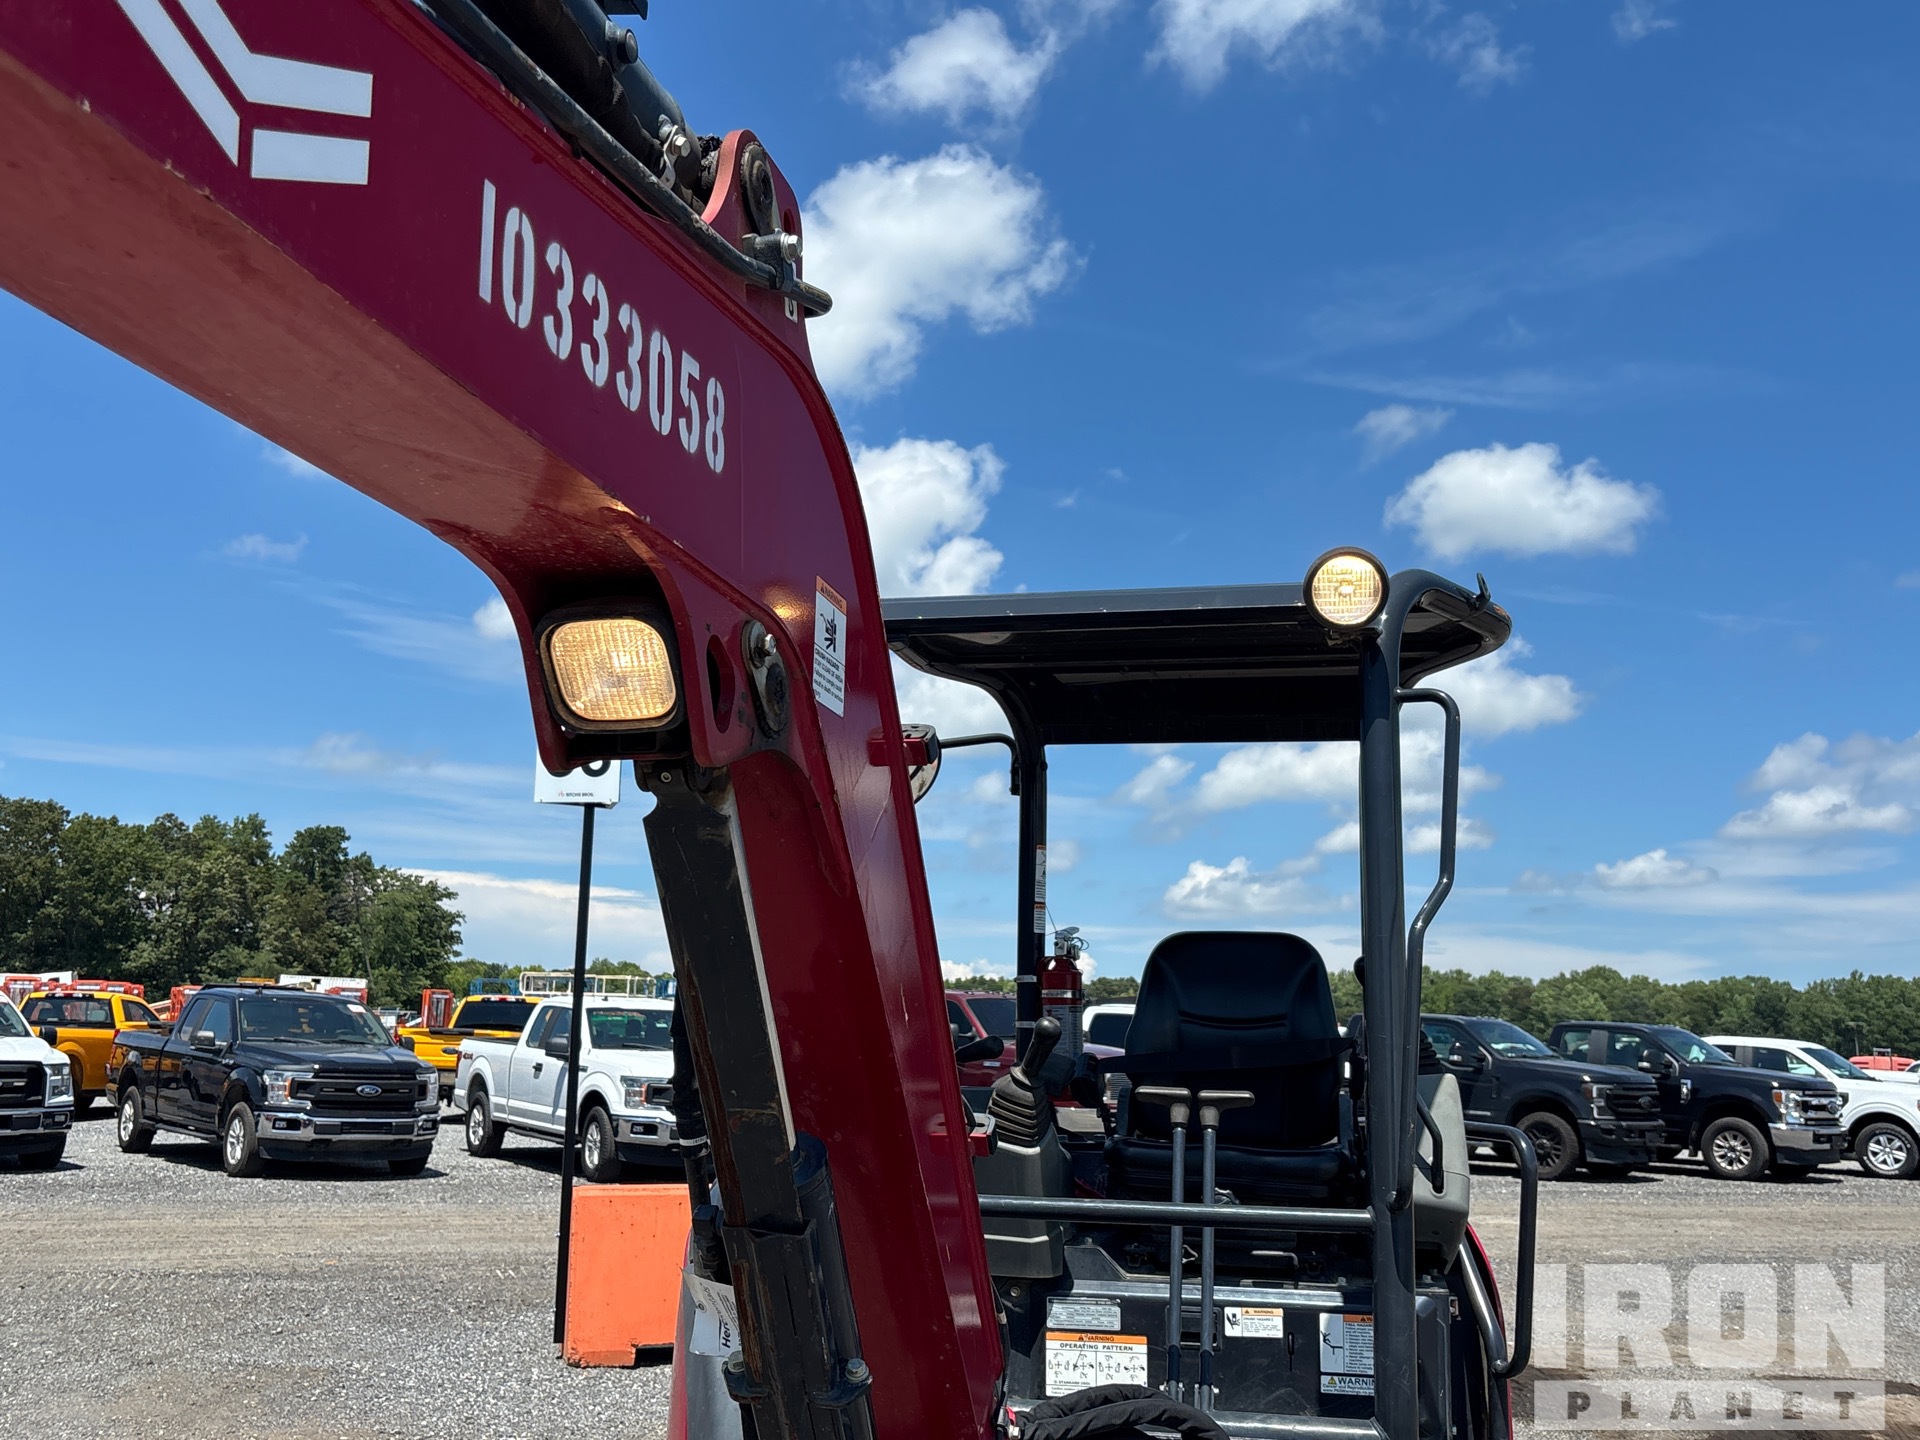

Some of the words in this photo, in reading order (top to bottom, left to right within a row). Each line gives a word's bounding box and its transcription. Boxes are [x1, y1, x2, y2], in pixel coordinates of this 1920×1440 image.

[479, 179, 725, 473] 10333058
[1060, 1342, 1099, 1350] OPERATING
[1338, 1377, 1375, 1387] WARNIN
